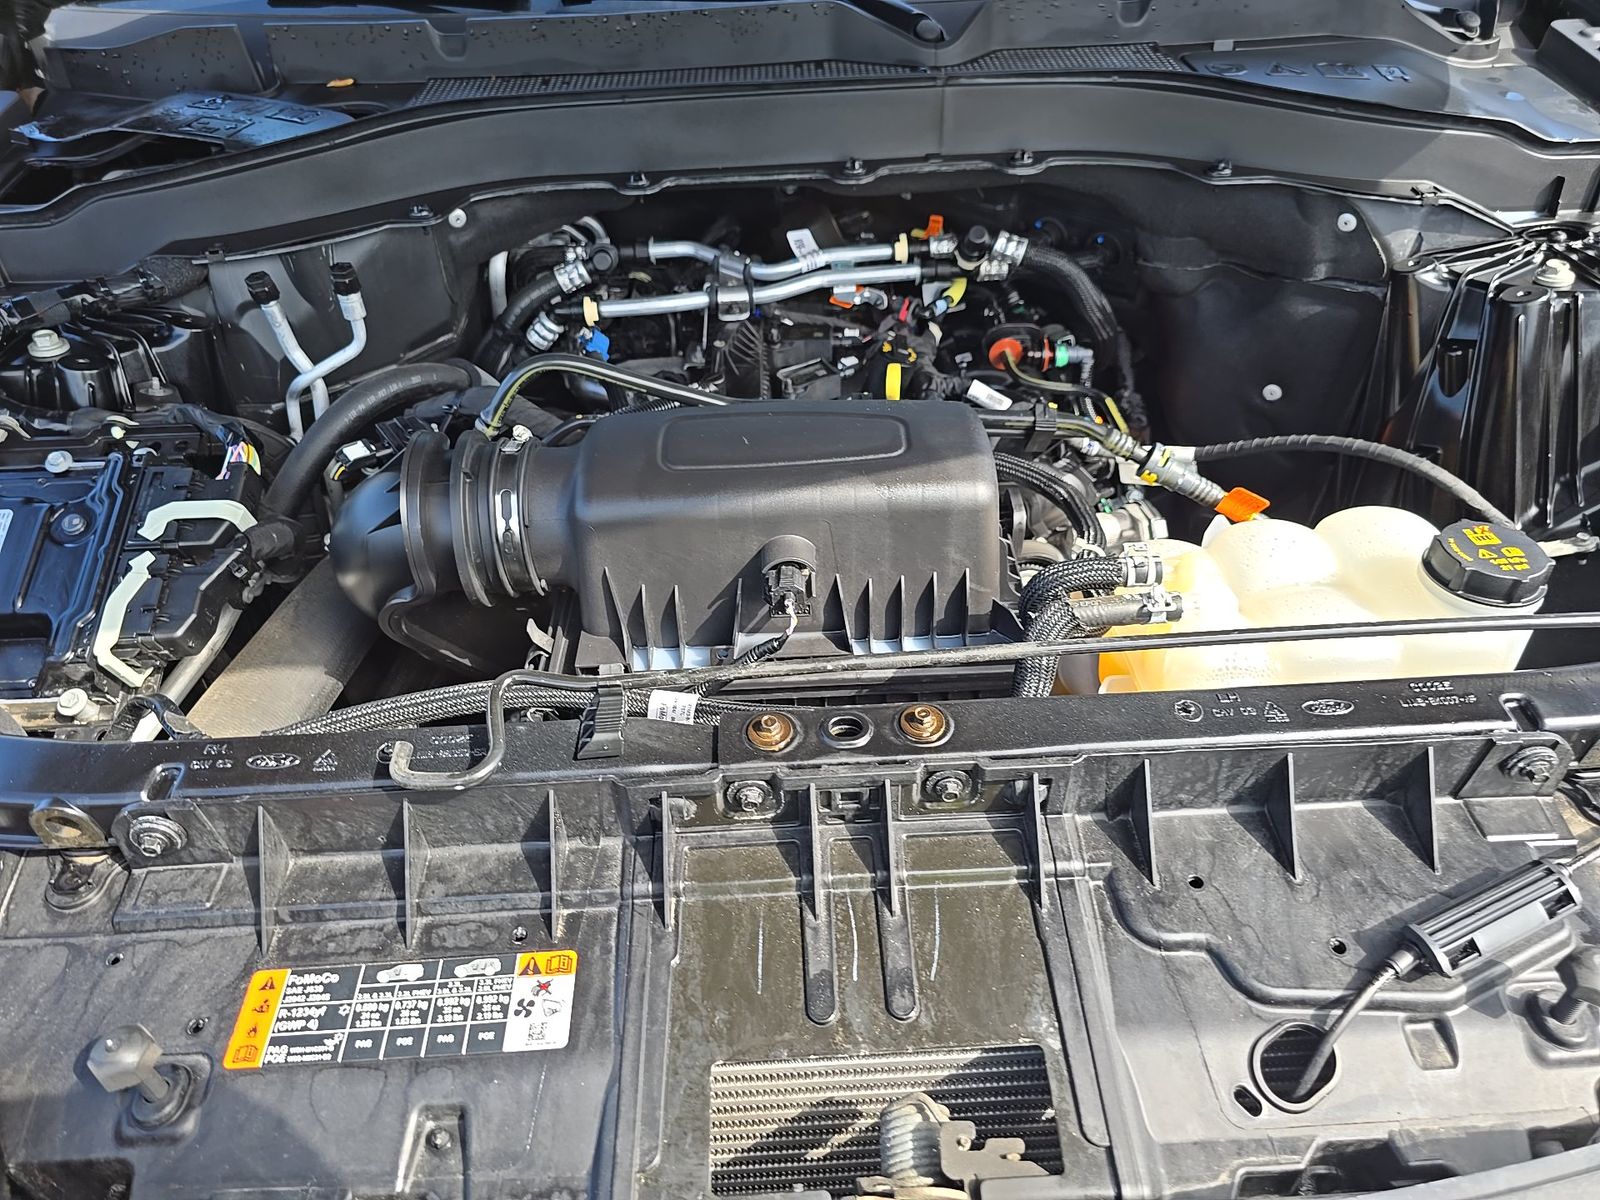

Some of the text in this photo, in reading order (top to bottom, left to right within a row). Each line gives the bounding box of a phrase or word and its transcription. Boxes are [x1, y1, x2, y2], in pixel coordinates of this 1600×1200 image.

[288, 972, 340, 986] FoMoCo
[286, 986, 304, 995] SAE
[417, 1000, 429, 1010] kg
[459, 996, 471, 1007] kg
[498, 994, 510, 1005] kg
[278, 1005, 328, 1018] R-1234yf
[378, 1002, 390, 1013] kg
[274, 1019, 319, 1033] (GWP 4)
[355, 1038, 373, 1048] PAG
[267, 1045, 288, 1055] PAG
[264, 1054, 287, 1064] POE
